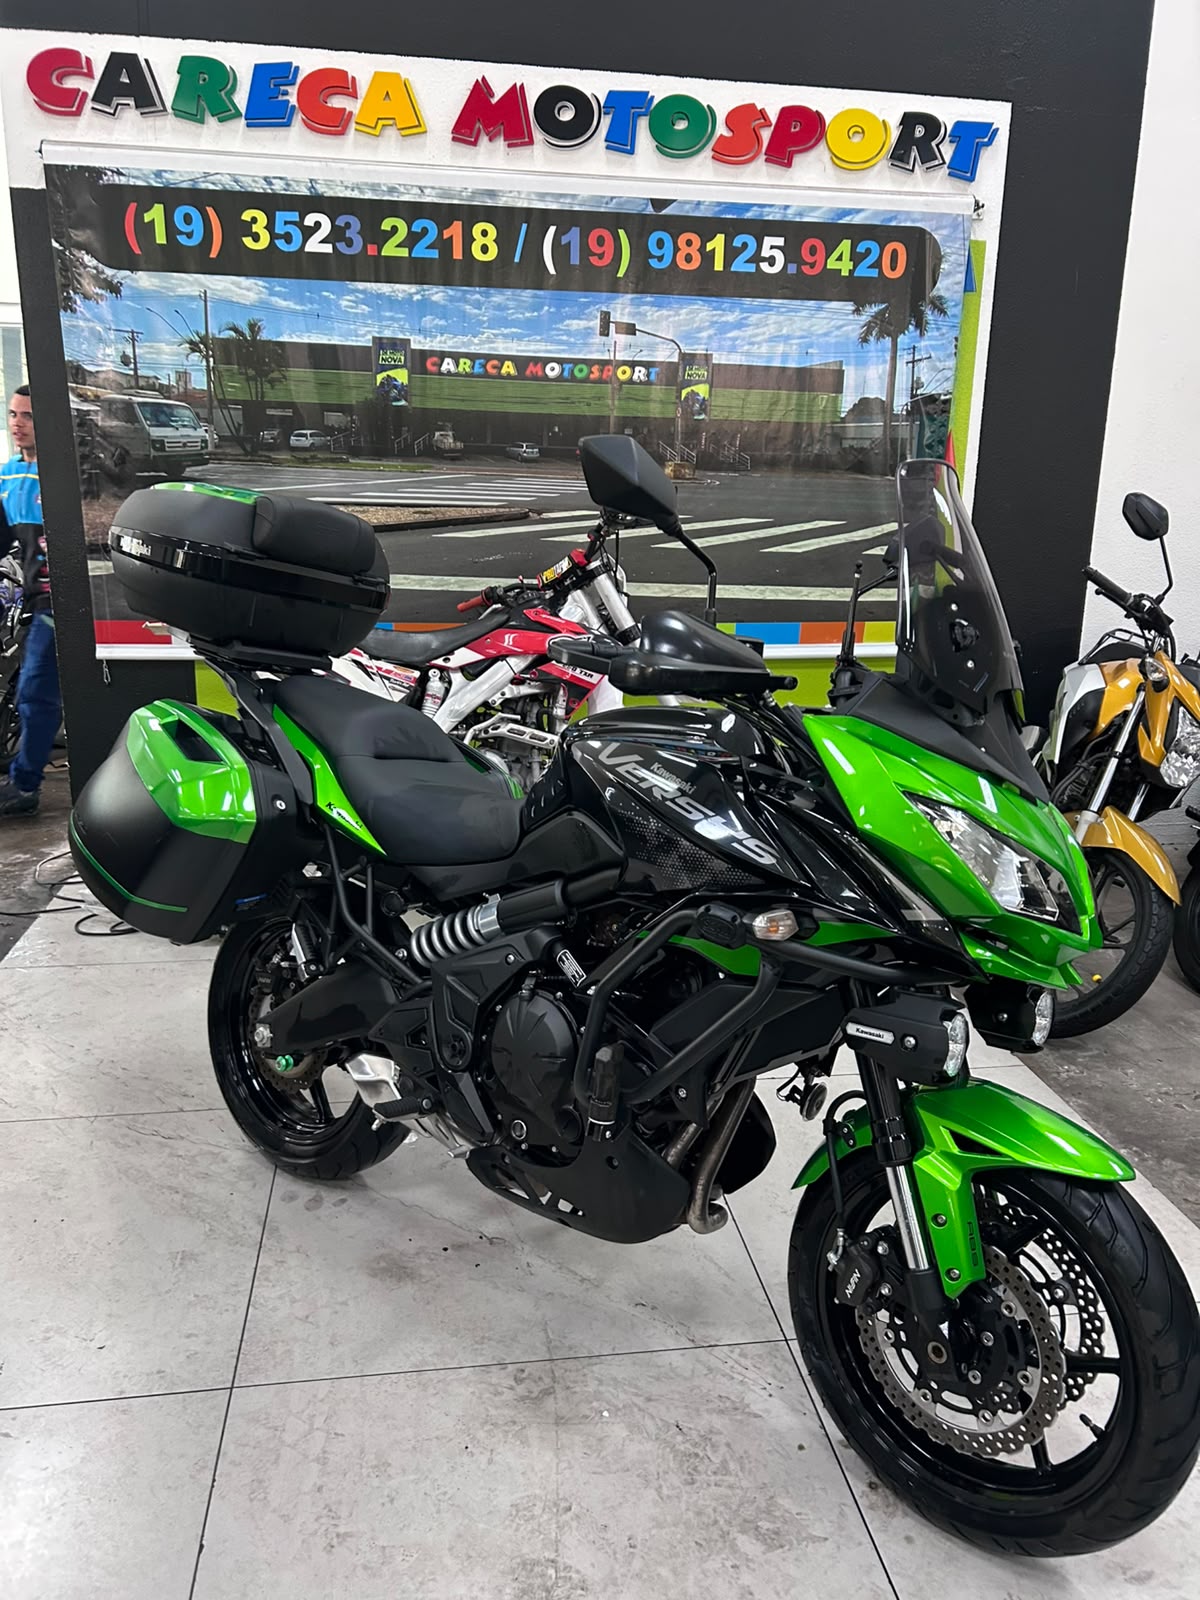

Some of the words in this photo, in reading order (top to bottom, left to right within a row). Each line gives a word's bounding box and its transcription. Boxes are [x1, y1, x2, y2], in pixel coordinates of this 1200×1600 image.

[26, 47, 427, 136] CARECA
[451, 76, 998, 182] MOTOSPORT
[124, 203, 222, 258] (19)
[241, 209, 498, 262] 3523.2218
[542, 225, 630, 277] (19)
[648, 231, 907, 279] 98125.9420
[381, 356, 403, 364] NOVA
[426, 356, 517, 377] CARECA
[525, 361, 660, 382] MOTOSPORT
[686, 371, 707, 379] NOVA
[650, 762, 697, 794] Kawasaki
[598, 742, 780, 865] VERSYS
[856, 1027, 885, 1039] Kawasaki
